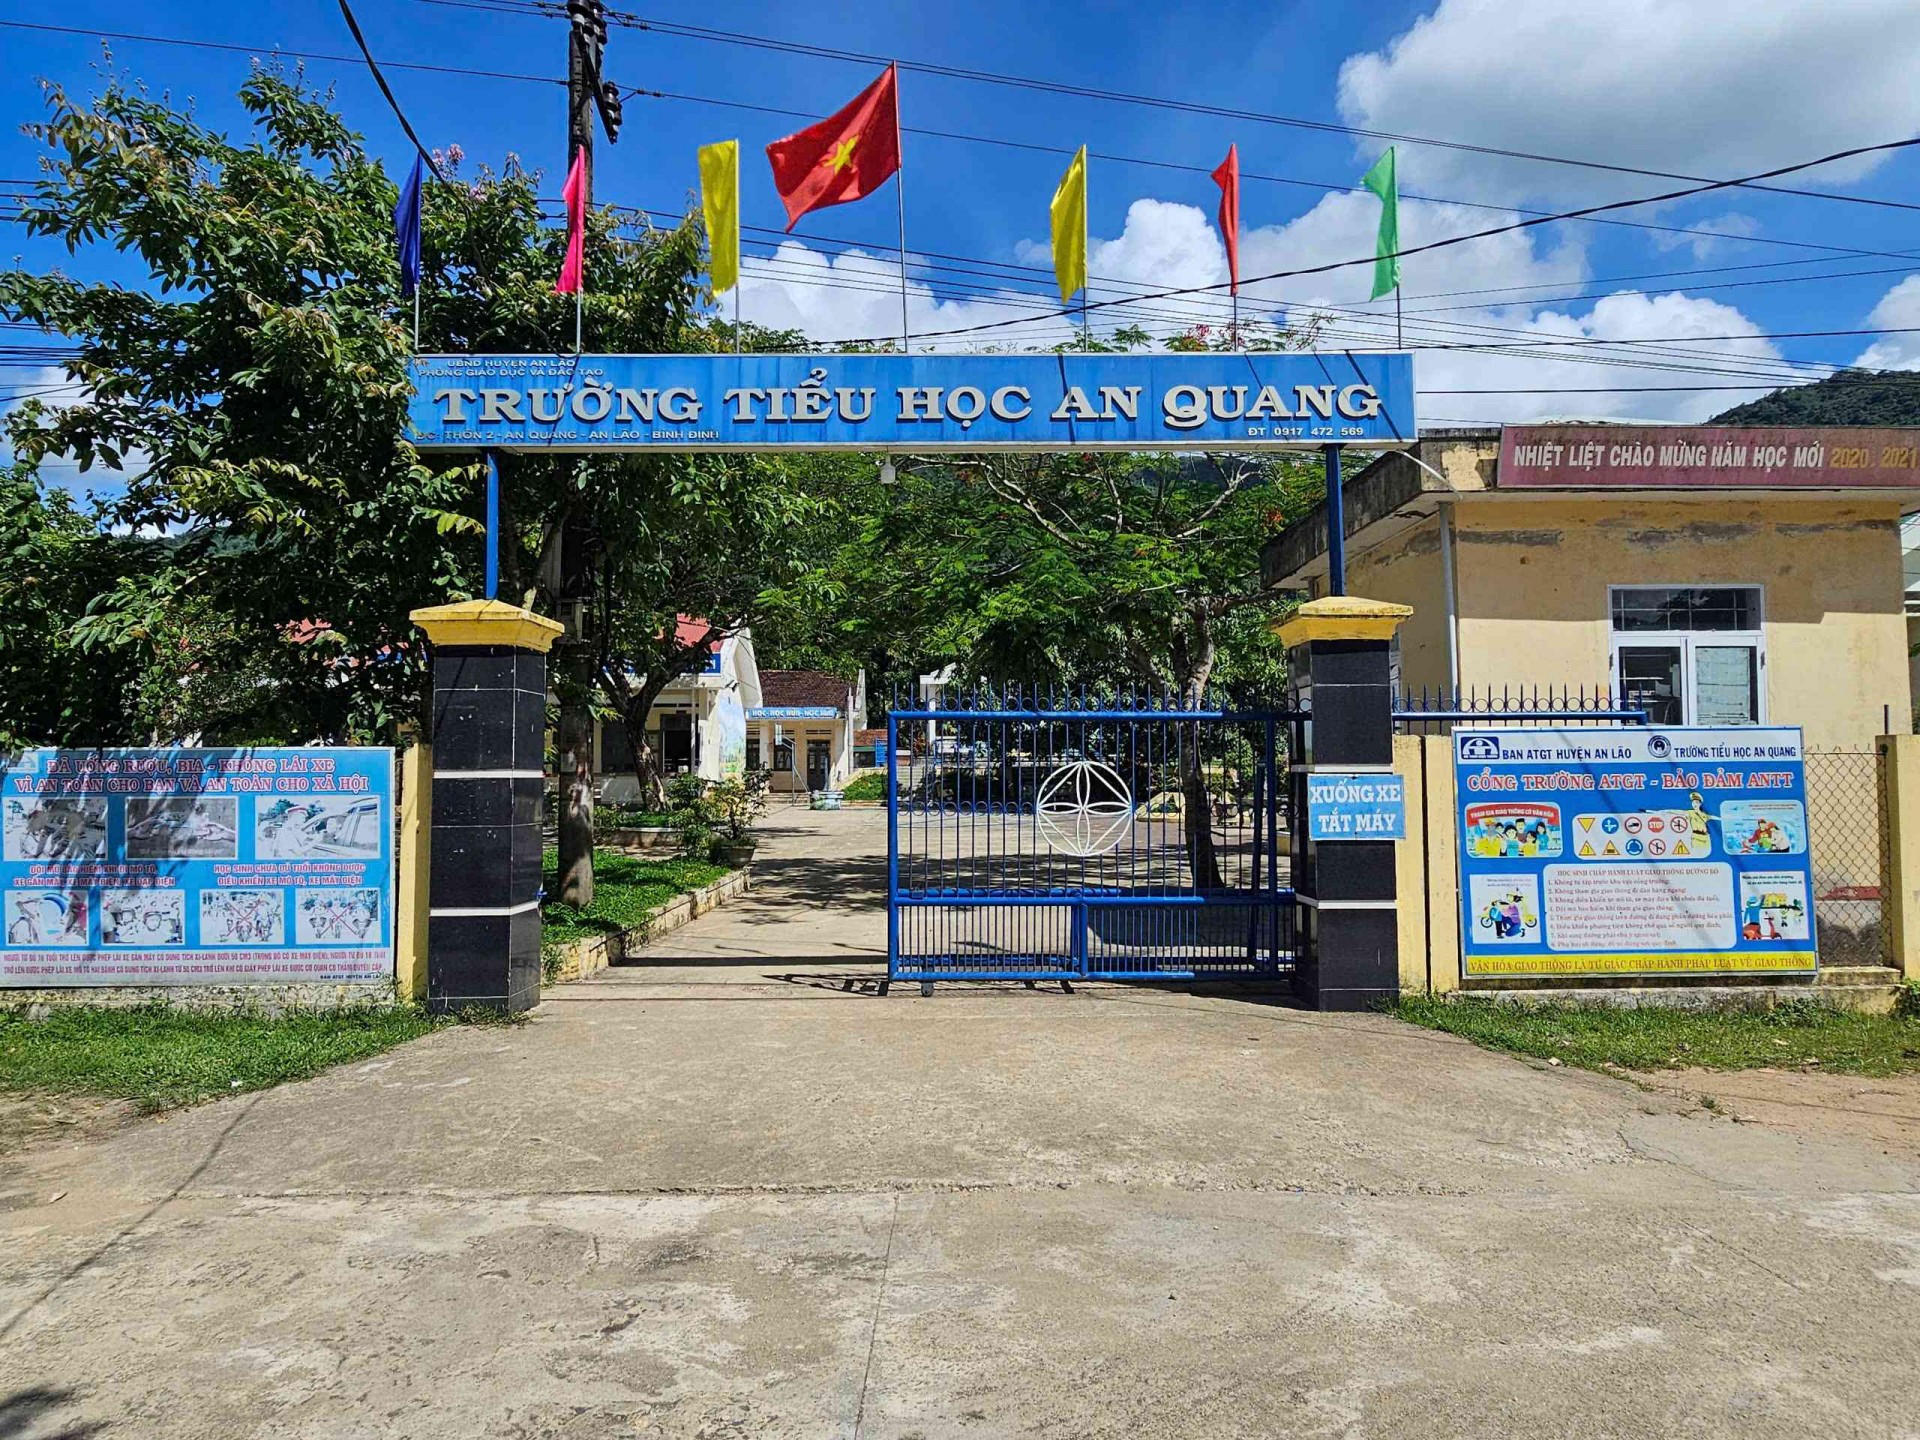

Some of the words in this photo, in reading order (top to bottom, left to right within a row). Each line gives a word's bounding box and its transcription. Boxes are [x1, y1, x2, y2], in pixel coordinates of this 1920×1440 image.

[447, 359, 481, 367] UBND
[529, 359, 547, 367] AN
[500, 369, 525, 378] DỤC
[530, 367, 546, 376] VÀ
[434, 377, 702, 421] TRƯỜNG
[724, 367, 876, 420] TIỂU
[897, 386, 1032, 428] HỌC
[1051, 386, 1142, 419] AN
[1163, 385, 1381, 427] QUANG
[444, 429, 482, 439] THÔN
[486, 431, 494, 439] 2
[504, 431, 525, 439] AN
[528, 431, 577, 439] QUANG
[589, 431, 608, 439] AN
[612, 429, 640, 439] LÃO
[652, 429, 684, 439] BÌNH
[693, 430, 719, 441] ĐỊNH
[1248, 428, 1265, 436] ĐT
[1274, 428, 1303, 436] 0917
[1311, 428, 1333, 436] 472
[1340, 428, 1363, 436] 569
[1514, 441, 1564, 471] NHIỆT
[1568, 441, 1605, 471] LIỆT
[1609, 441, 1654, 467] CHÀO
[1659, 439, 1706, 467] MỪNG
[1711, 441, 1747, 467] NĂM
[1753, 446, 1787, 472] HỌC
[1793, 440, 1825, 468] MỚI
[1829, 448, 1869, 468] 2020
[1880, 448, 1918, 468] 2021
[1502, 750, 1523, 760] BAN
[1527, 749, 1551, 760] ATGT
[1556, 746, 1591, 762] HUYỆN
[1594, 749, 1608, 759] AN
[1611, 746, 1632, 759] LÃO
[1674, 745, 1709, 758] TRƯỜNG
[1711, 742, 1731, 758] TIỂU
[1734, 747, 1751, 760] HỌC
[1754, 748, 1766, 757] AN
[1768, 747, 1796, 759] QUANG
[47, 757, 71, 774] ĐÃ
[76, 752, 119, 774] UỐNG
[177, 758, 206, 774] BIA
[218, 756, 276, 773] KHÔNG
[280, 755, 308, 773] LÁI
[311, 758, 336, 773] XE
[14, 775, 33, 792] VÌ
[36, 778, 57, 792] AN
[62, 775, 104, 792] TOÀN
[107, 778, 140, 792] CHO
[143, 778, 175, 795] BẠN
[178, 775, 202, 792] VÀ
[205, 777, 227, 792] AN
[231, 774, 273, 792] TOÀN
[276, 776, 309, 791] CHO
[311, 774, 337, 791] XÃ
[338, 773, 369, 794] HỘI
[1467, 767, 1517, 791] CỔNG
[1522, 770, 1595, 791] TRƯỜNG
[1599, 773, 1646, 790] ATGT
[1662, 768, 1699, 790] BẢO
[1703, 767, 1744, 789] ĐẢM
[1747, 772, 1794, 788] ANTT
[1310, 778, 1375, 804] XUỐNG
[1376, 784, 1401, 802] XE
[1318, 806, 1352, 833] TẮT
[1355, 808, 1396, 832] MÁY
[1514, 961, 1537, 970] GIAO
[1539, 959, 1572, 970] THÔNG
[1604, 958, 1627, 969] GIÁC
[1755, 957, 1777, 967] GIAO
[1780, 955, 1812, 967] THÔNG
